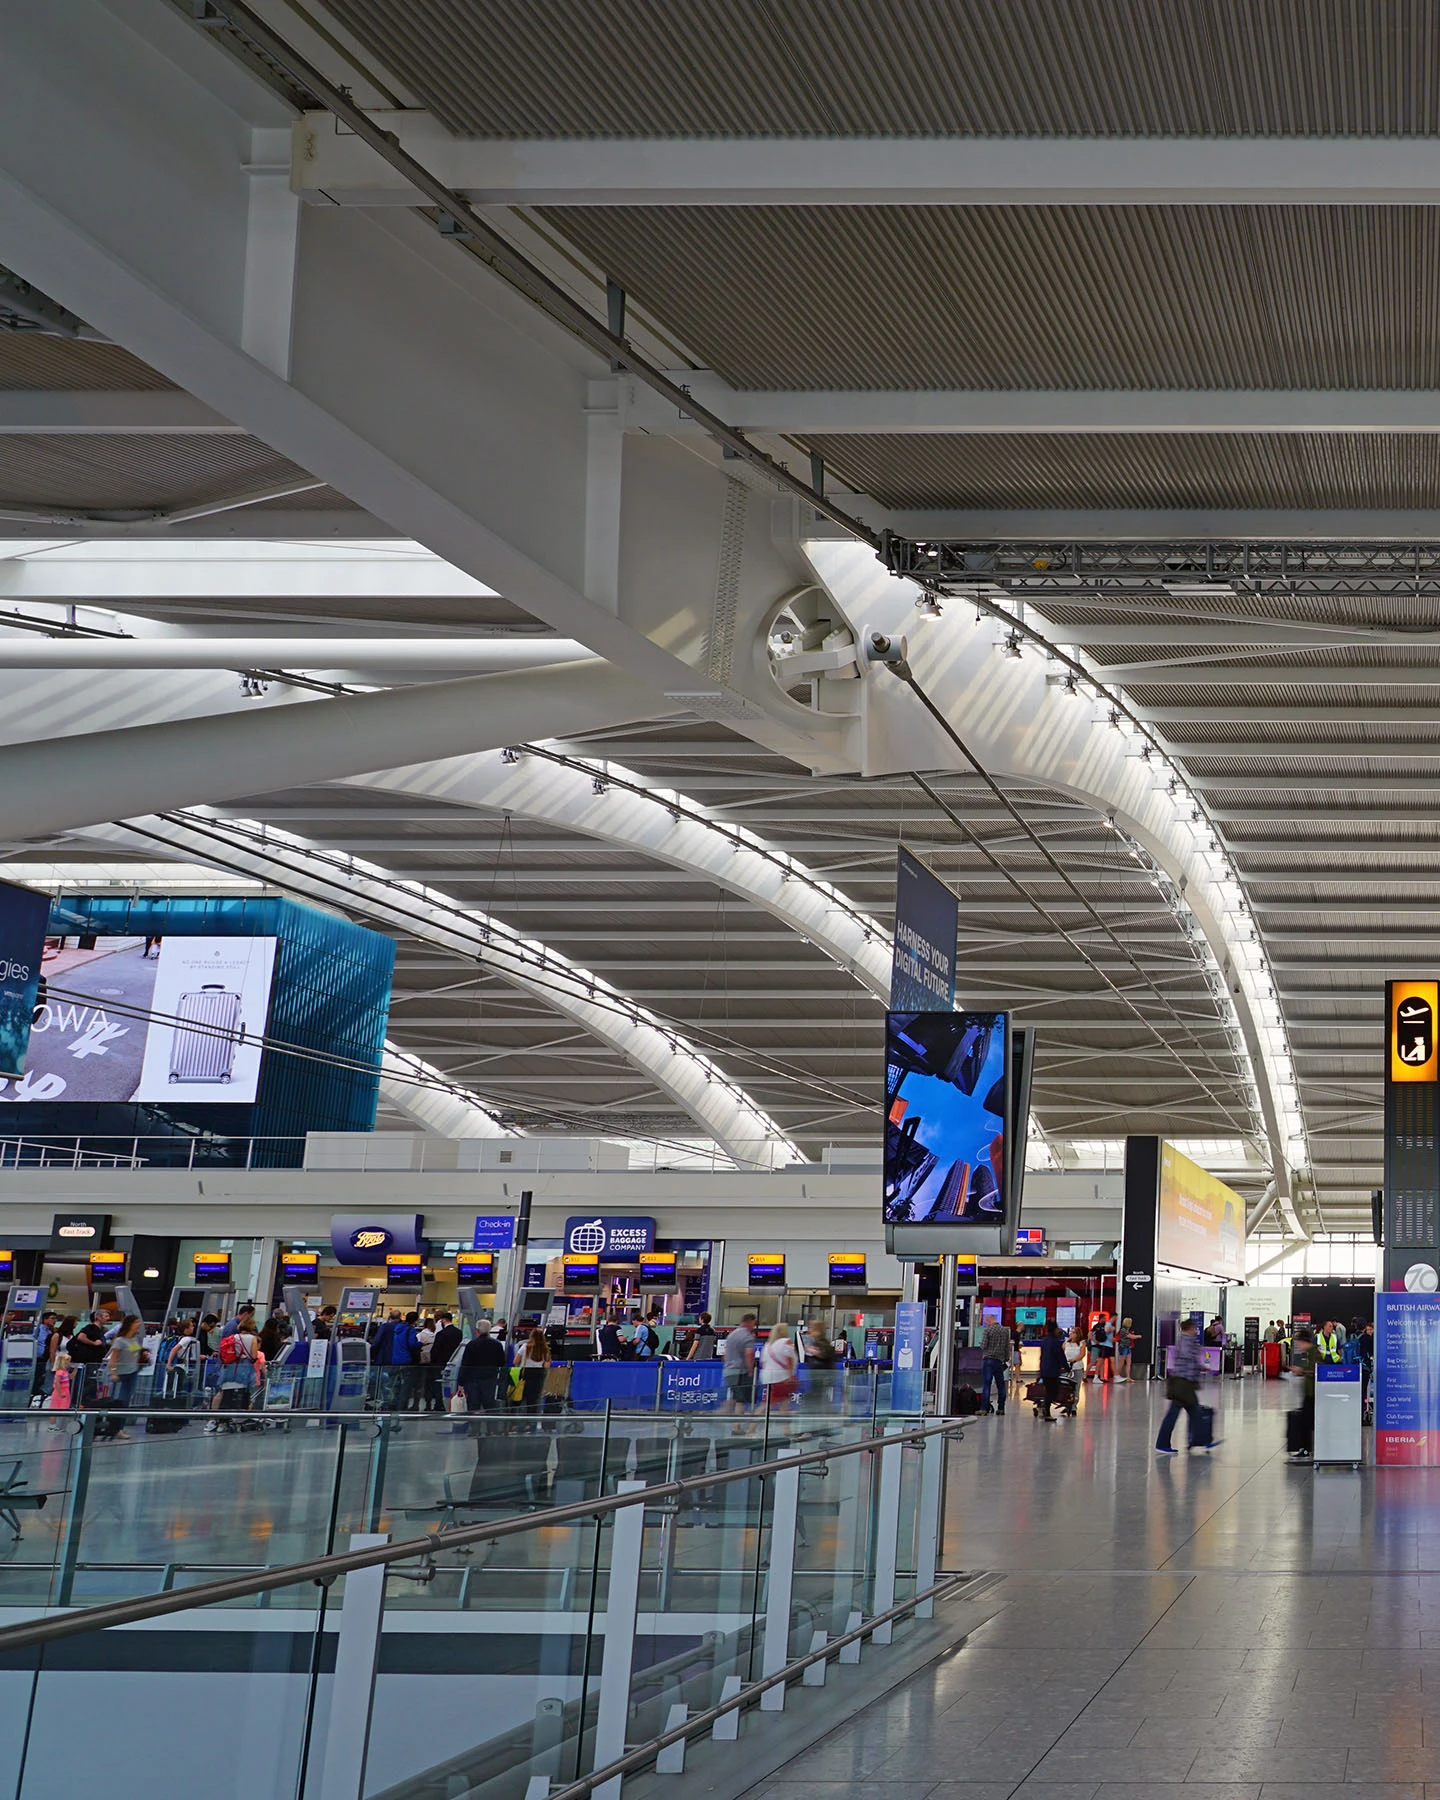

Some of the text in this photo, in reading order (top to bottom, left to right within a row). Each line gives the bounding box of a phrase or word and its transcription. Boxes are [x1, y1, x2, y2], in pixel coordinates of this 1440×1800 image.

[897, 920, 949, 976] HARNESS YOUR
[895, 946, 923, 984] DIGITAL
[479, 1220, 511, 1228] Check-in
[353, 1231, 386, 1248] Boots
[611, 1229, 647, 1237] EXCESS
[1408, 1267, 1439, 1292] 70
[668, 1374, 701, 1386] Hand
